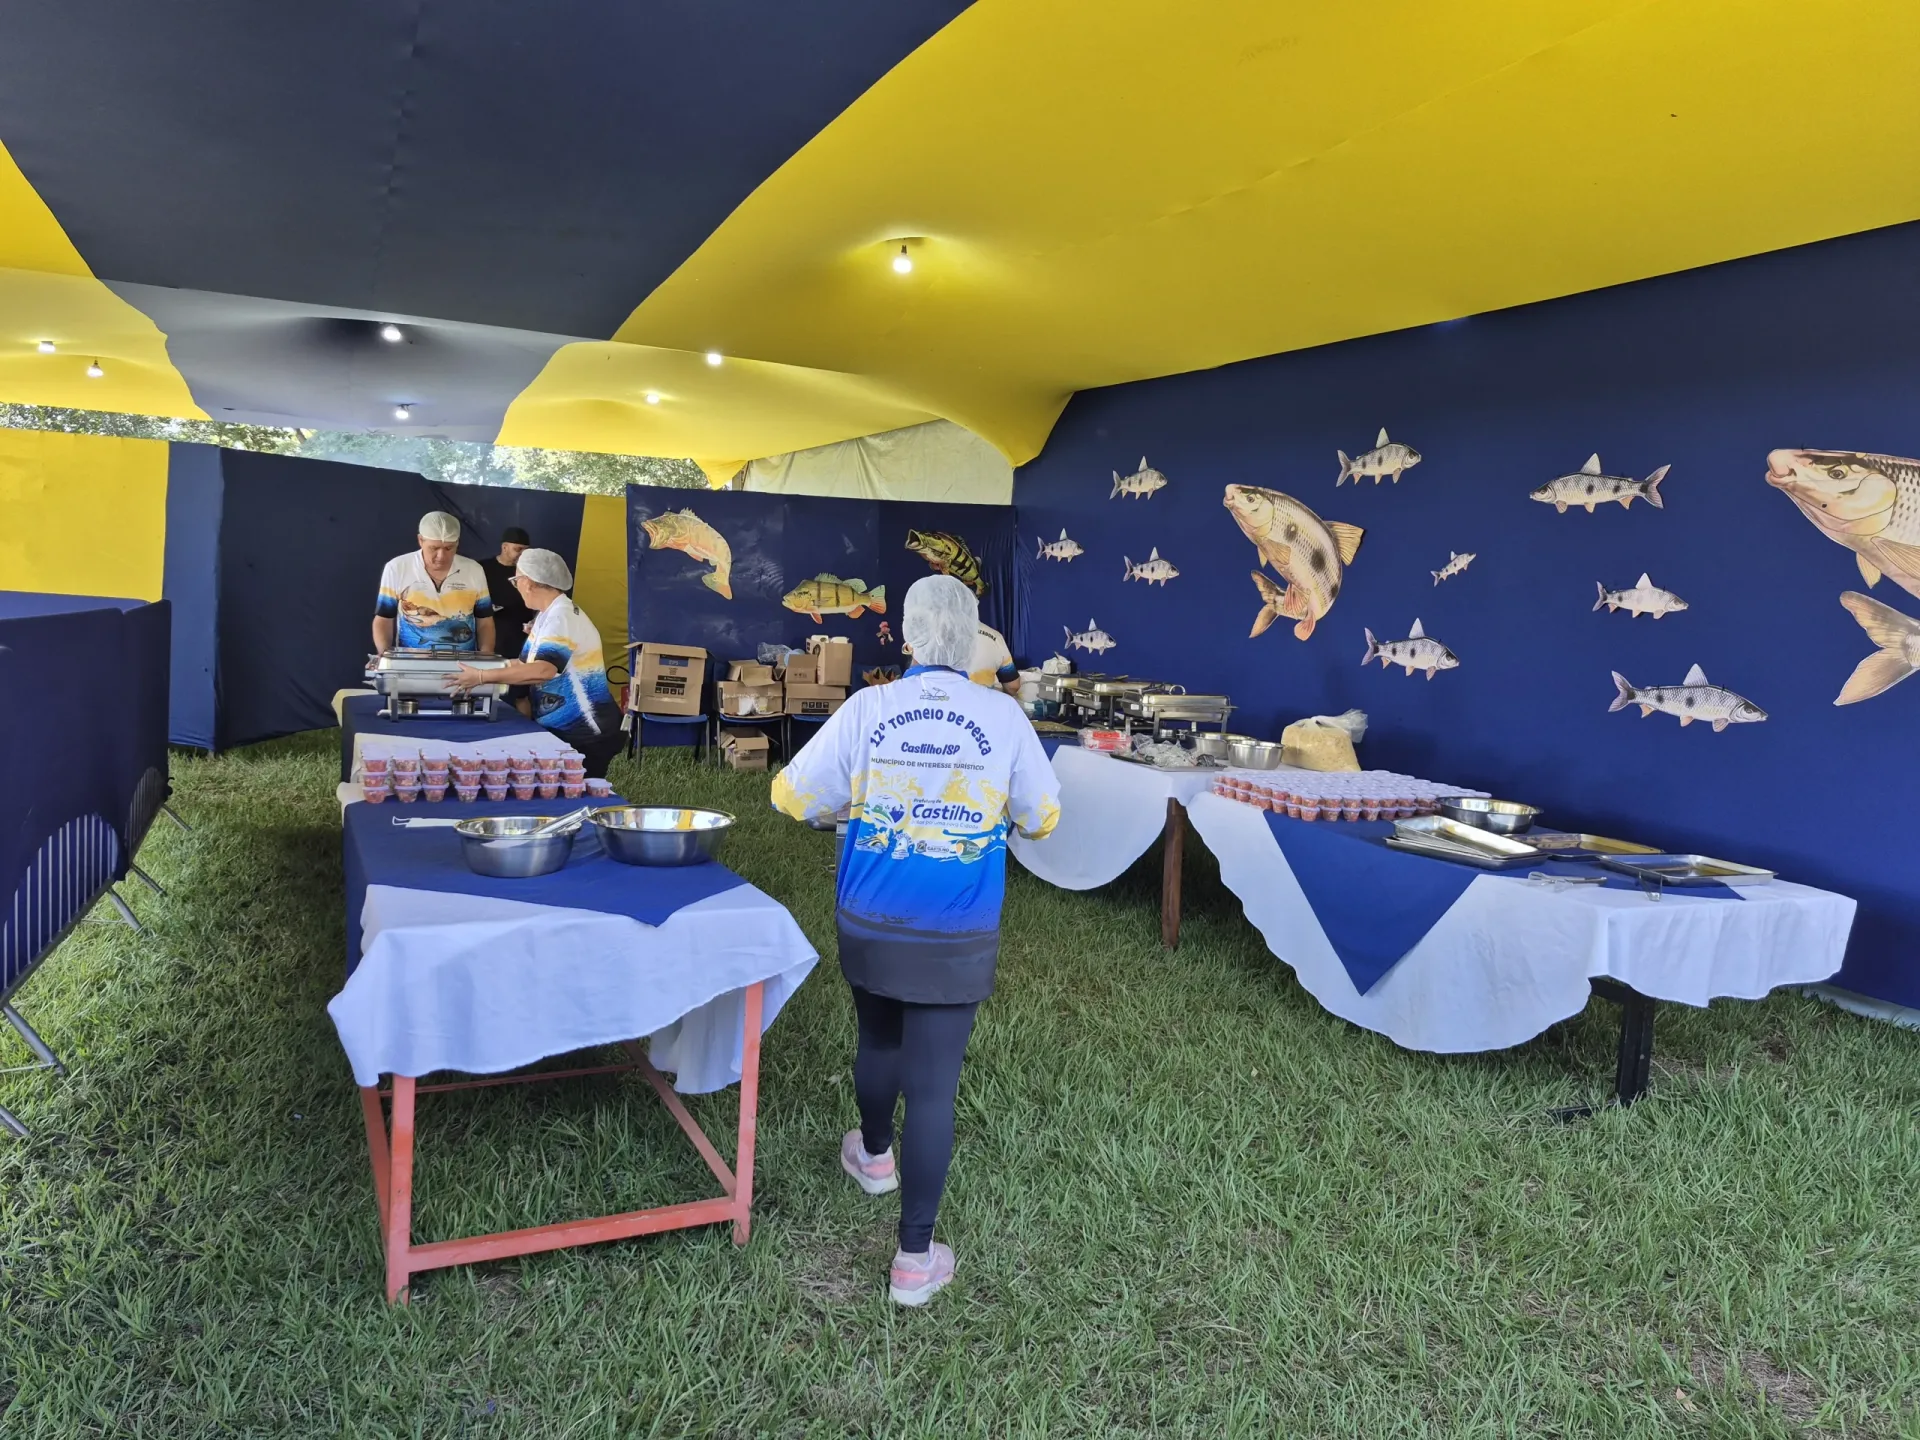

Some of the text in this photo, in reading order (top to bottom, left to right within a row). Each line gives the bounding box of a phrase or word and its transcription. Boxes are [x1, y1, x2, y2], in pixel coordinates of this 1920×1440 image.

[900, 741, 961, 756] Castilho/SP
[870, 757, 906, 767] MUNICÍPIO
[916, 761, 952, 770] INTERESSE
[953, 761, 985, 771] TURÍSTICO
[912, 803, 983, 824] Castilho
